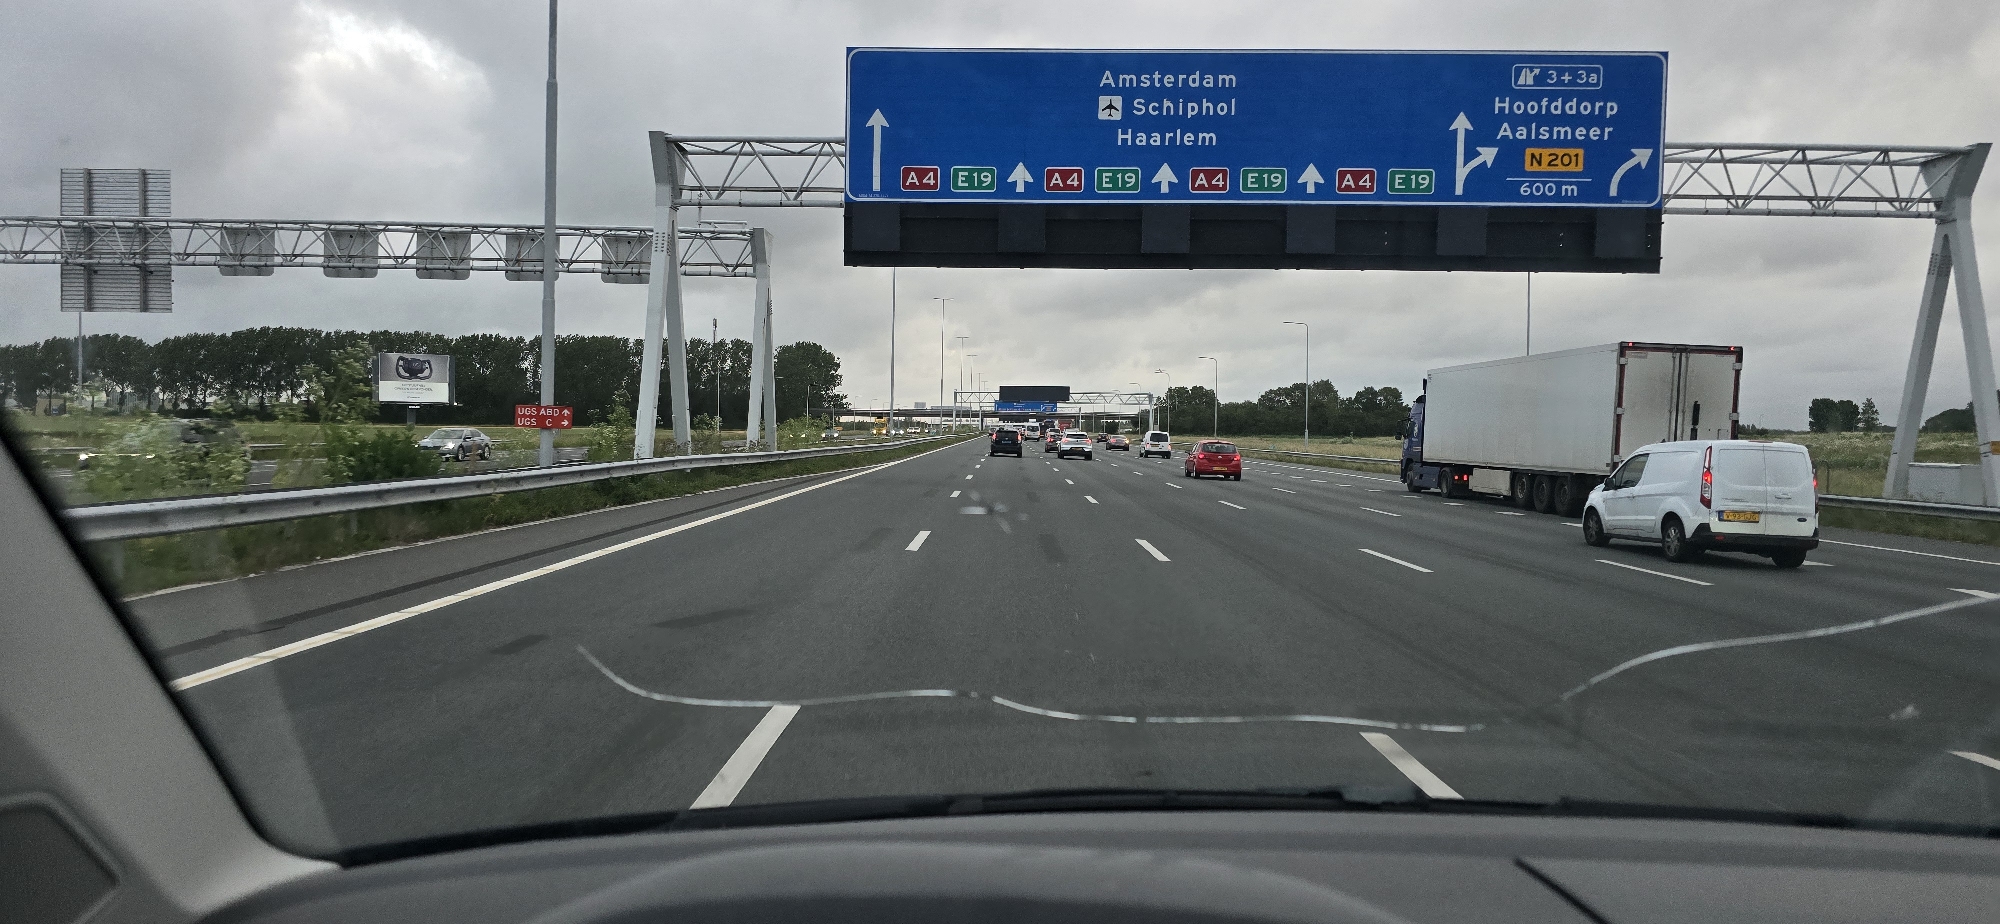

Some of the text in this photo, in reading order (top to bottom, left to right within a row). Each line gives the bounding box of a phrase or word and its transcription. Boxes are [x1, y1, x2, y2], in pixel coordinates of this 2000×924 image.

[1099, 70, 1237, 88] Amsterdam
[1132, 97, 1236, 119] Schiphol
[1494, 96, 1618, 119] Hoofddorp
[1117, 128, 1217, 146] Haarlem
[1496, 122, 1614, 141] Aalsmeer
[1519, 182, 1578, 197] 600 m
[517, 407, 560, 417] UGS ABD
[517, 417, 553, 427] UGS C
